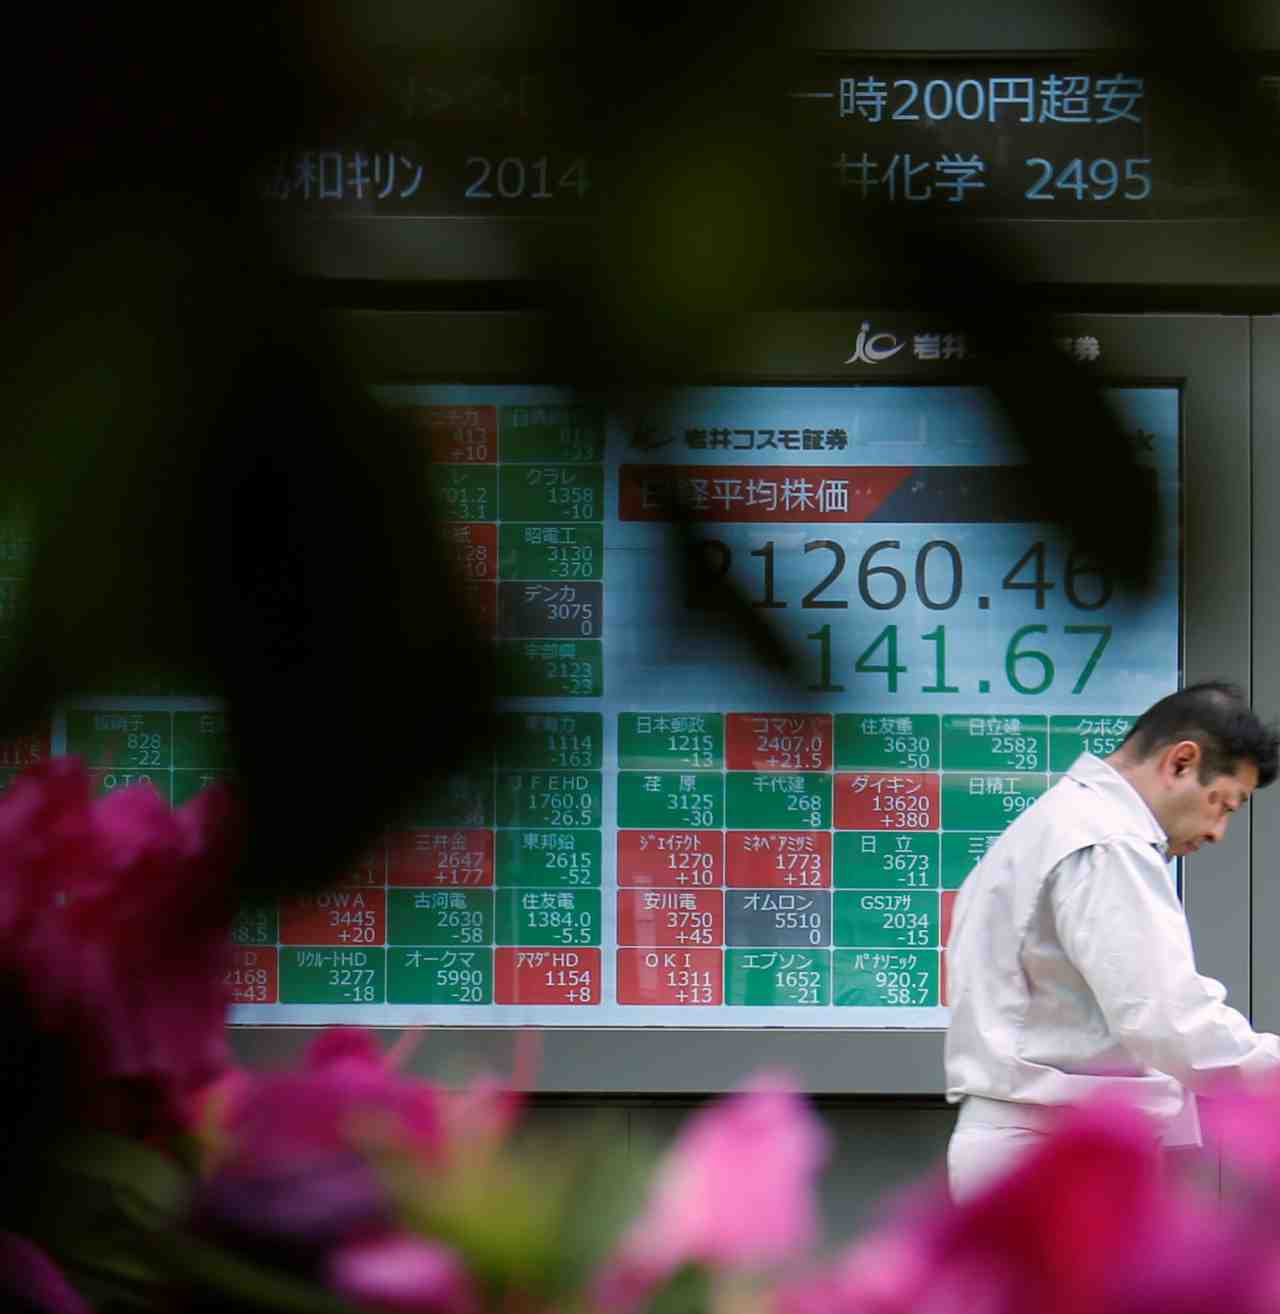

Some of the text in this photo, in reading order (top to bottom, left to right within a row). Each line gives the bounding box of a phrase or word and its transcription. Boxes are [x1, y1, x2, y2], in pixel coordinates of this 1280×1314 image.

[786, 74, 1144, 122] 一時200円超安
[1025, 157, 1152, 201] 2495
[547, 545, 593, 561] 3130
[551, 562, 593, 577] -370
[524, 585, 577, 603] デンカ
[547, 604, 593, 620] 3075
[806, 623, 1112, 695] 141.67
[752, 717, 806, 733] コマツ
[1077, 719, 1129, 736] クボタ
[668, 736, 713, 751] 1215
[884, 737, 929, 754] 3630
[992, 738, 1038, 754] 2582
[683, 753, 713, 768] -13
[899, 754, 929, 769] -50
[1008, 755, 1038, 770] -29
[851, 776, 922, 794] ダイキン
[529, 793, 592, 809] 1760.0
[668, 794, 713, 810] 3125
[787, 795, 822, 811] 268
[872, 796, 930, 812] 13620
[543, 810, 592, 826] -26.5
[683, 811, 713, 827] -30
[801, 812, 822, 827] -8
[880, 812, 930, 828] +380
[545, 852, 591, 869] 2615
[668, 854, 713, 870] 1270
[776, 854, 822, 870] 1773
[883, 854, 929, 870] 3673
[560, 870, 591, 885] -52
[676, 871, 713, 886] +10
[784, 871, 822, 887] +12
[898, 871, 929, 887] -11
[643, 892, 697, 911] 安川電
[743, 892, 815, 911] オムロン
[330, 911, 376, 927] 3445
[438, 911, 483, 928] 2630
[528, 912, 591, 928] 1384.0
[667, 912, 713, 929] 3750
[776, 913, 822, 929] 5510
[883, 913, 929, 929] 2034
[338, 928, 376, 943] +20
[452, 928, 483, 943] -58
[553, 928, 591, 944] -5.5
[676, 930, 713, 945] +45
[898, 930, 929, 945] -15
[405, 950, 476, 968] オークマ
[741, 952, 814, 970] エプソン
[329, 970, 376, 985] 3277
[436, 970, 483, 986] 5990
[545, 970, 591, 986] 1154
[668, 971, 712, 987] 1311
[776, 971, 822, 987] 1652
[876, 972, 929, 988] 920.7
[344, 986, 375, 1002] -18
[452, 987, 483, 1002] -20
[564, 987, 591, 1002] +8
[676, 988, 713, 1003] +13
[789, 989, 821, 1004] -21
[879, 989, 929, 1004] -58.7
